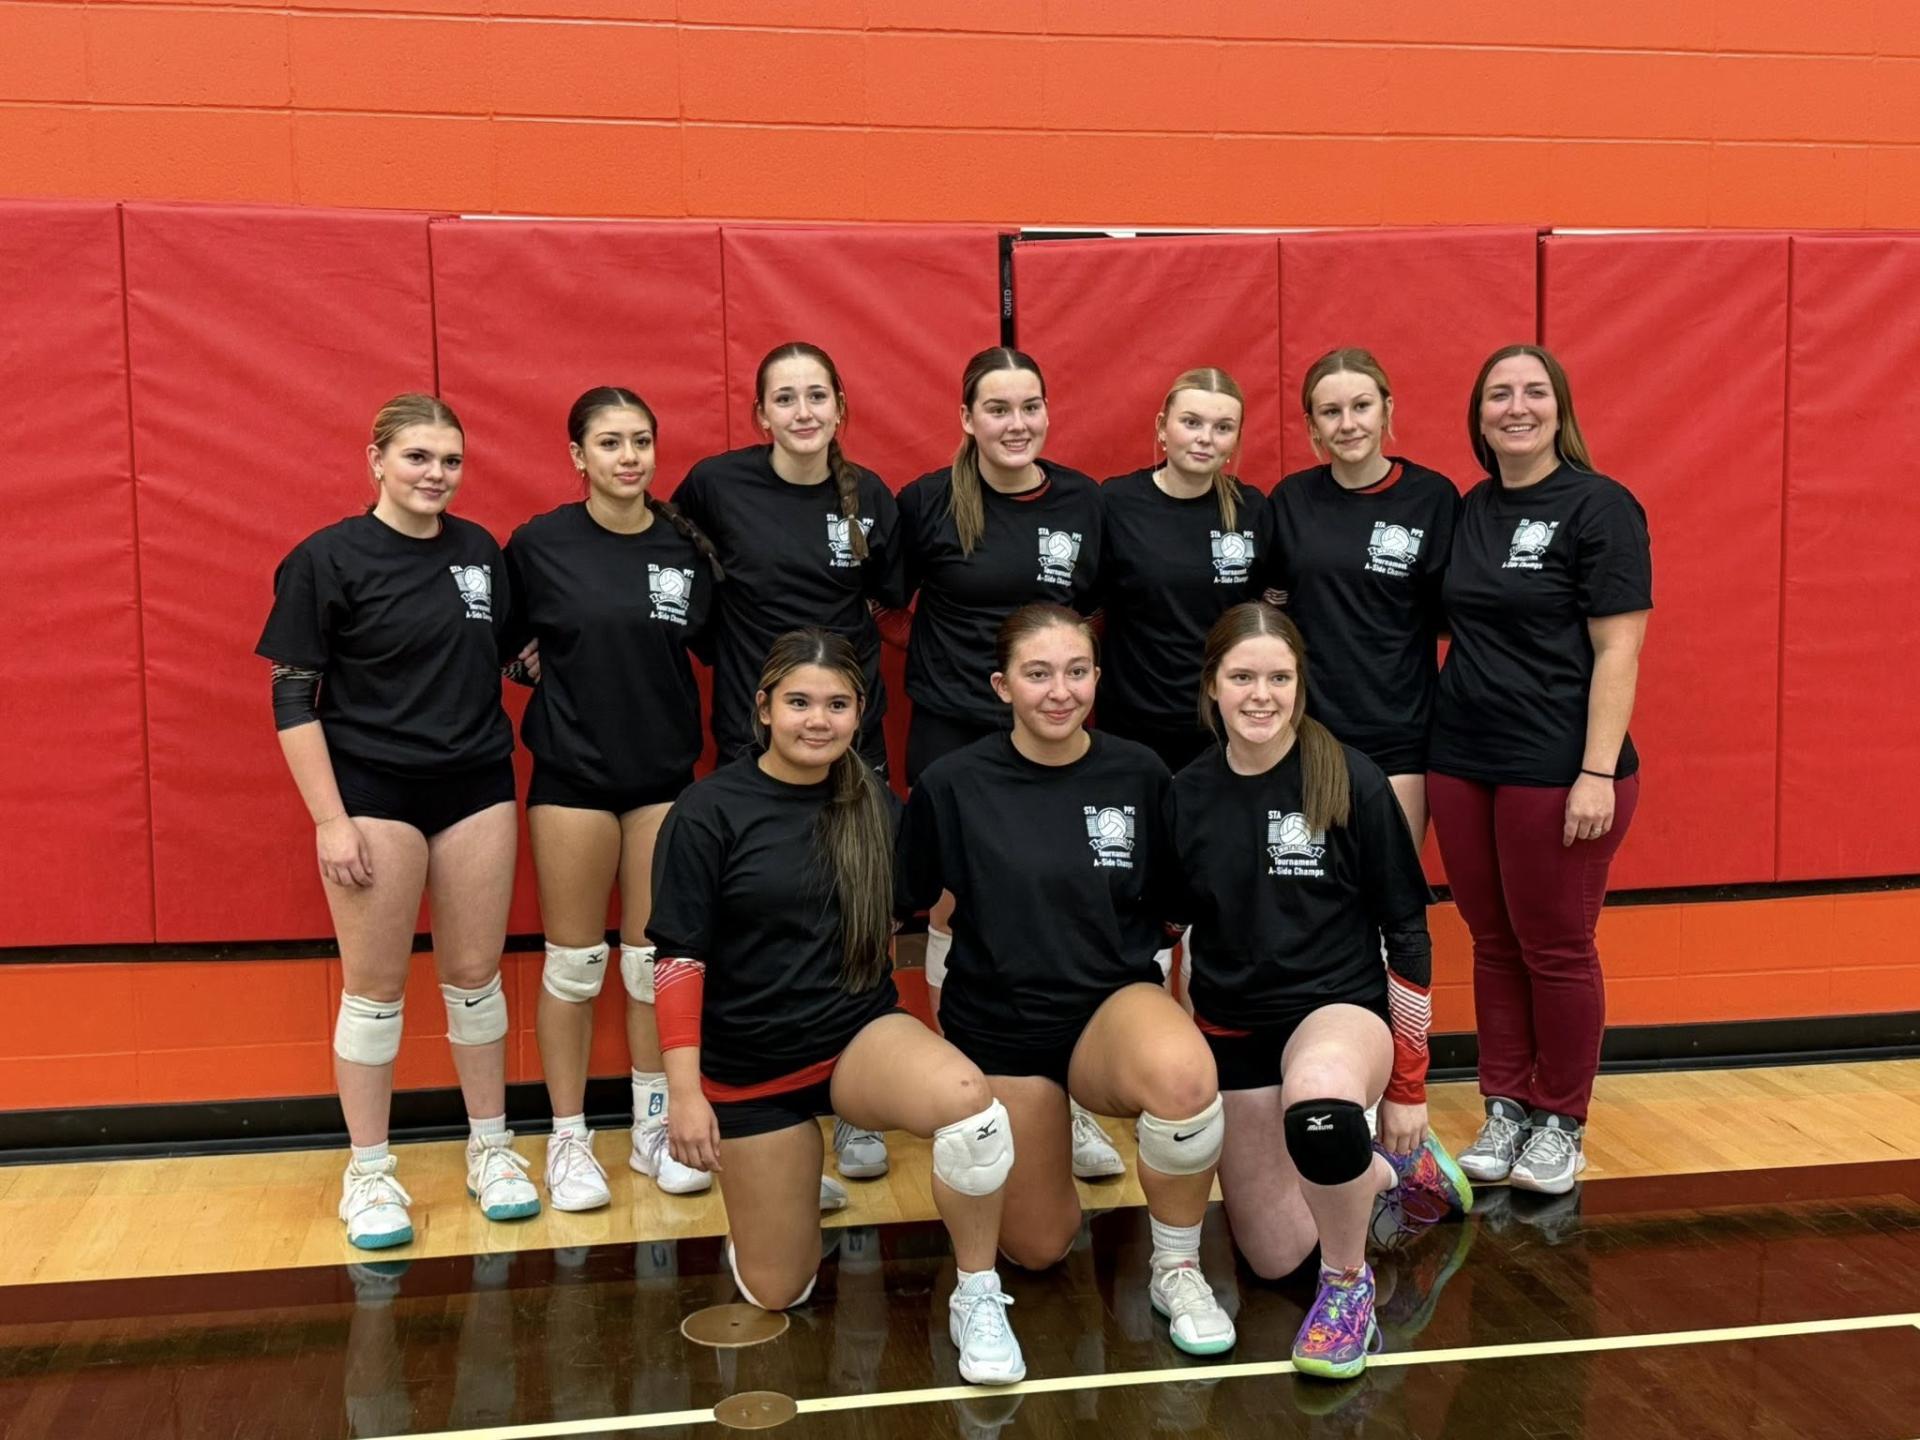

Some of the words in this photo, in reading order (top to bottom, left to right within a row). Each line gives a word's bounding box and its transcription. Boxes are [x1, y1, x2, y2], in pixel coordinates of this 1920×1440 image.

[826, 514, 839, 522] STA
[1038, 528, 1050, 536] STA
[1411, 528, 1424, 537] PPS
[647, 564, 660, 572] STA
[1364, 562, 1386, 574] A-Side
[1036, 573, 1056, 583] A-Side
[1213, 576, 1233, 584] A-Side
[649, 610, 670, 621] A-Side
[1083, 806, 1097, 816] STA
[1267, 811, 1282, 820] STA
[1093, 857, 1116, 868] A-Side
[1274, 856, 1318, 867] Tournament
[1267, 866, 1293, 876] A-Side
[1293, 867, 1325, 878] Champs
